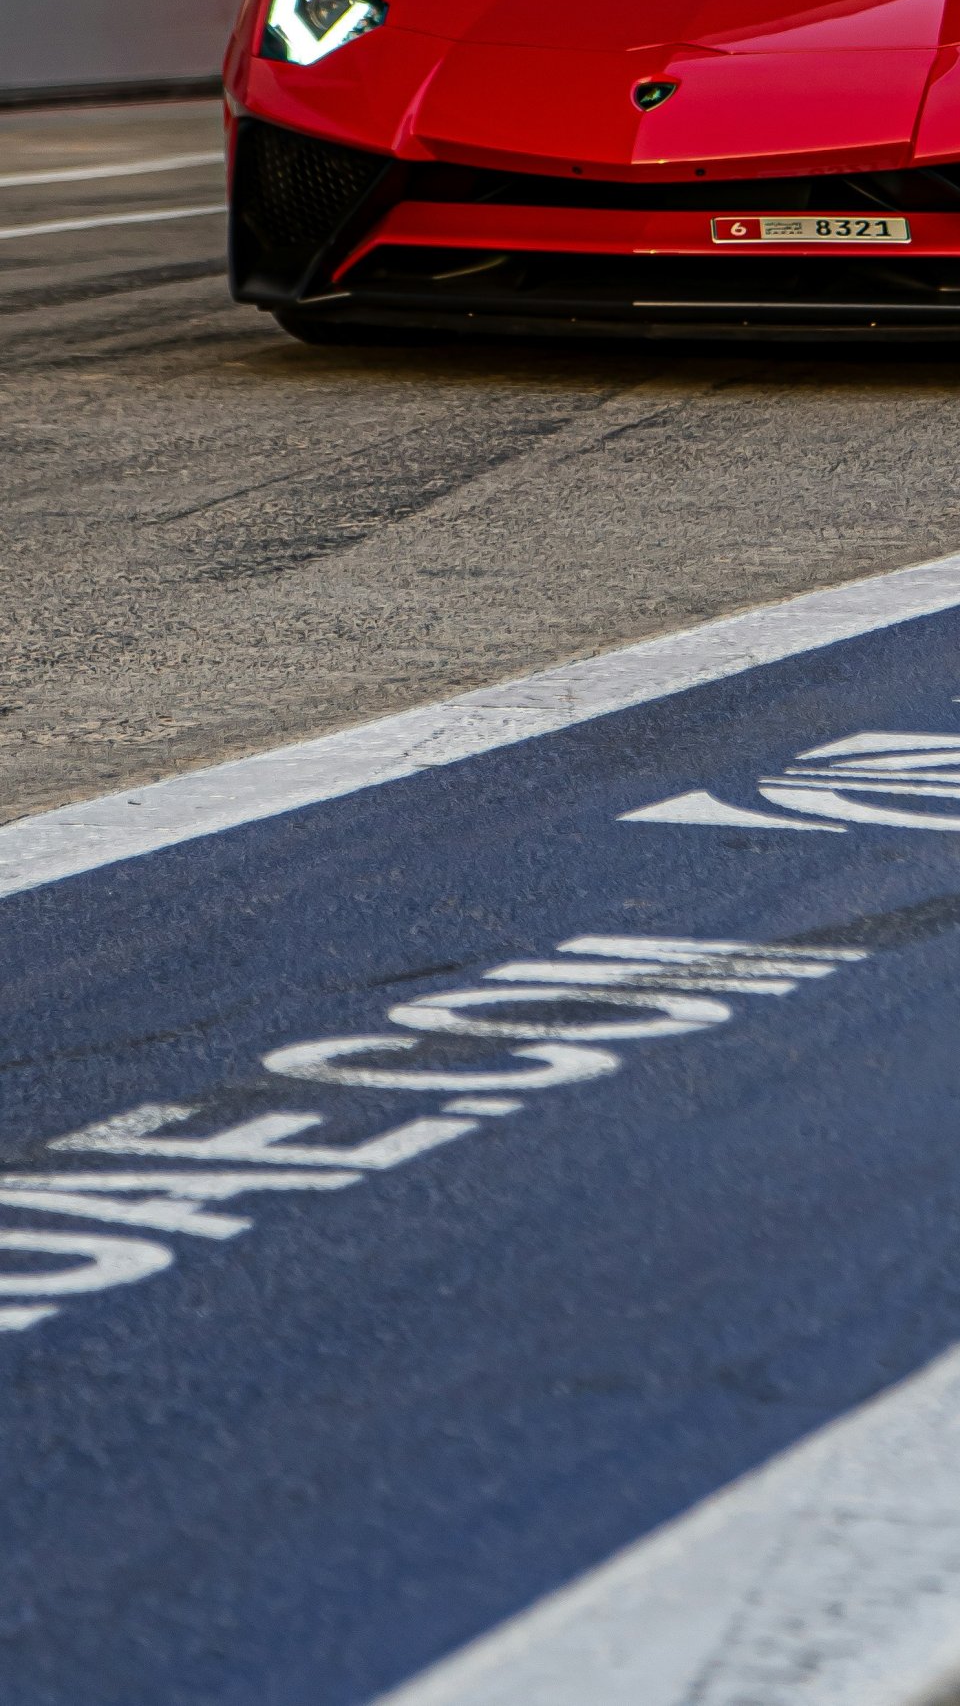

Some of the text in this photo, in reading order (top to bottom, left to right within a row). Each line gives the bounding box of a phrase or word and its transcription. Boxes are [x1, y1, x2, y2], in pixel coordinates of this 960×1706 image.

[730, 222, 747, 236] 6
[815, 220, 892, 236] 8321
[0, 936, 868, 1332] UAE.COM
